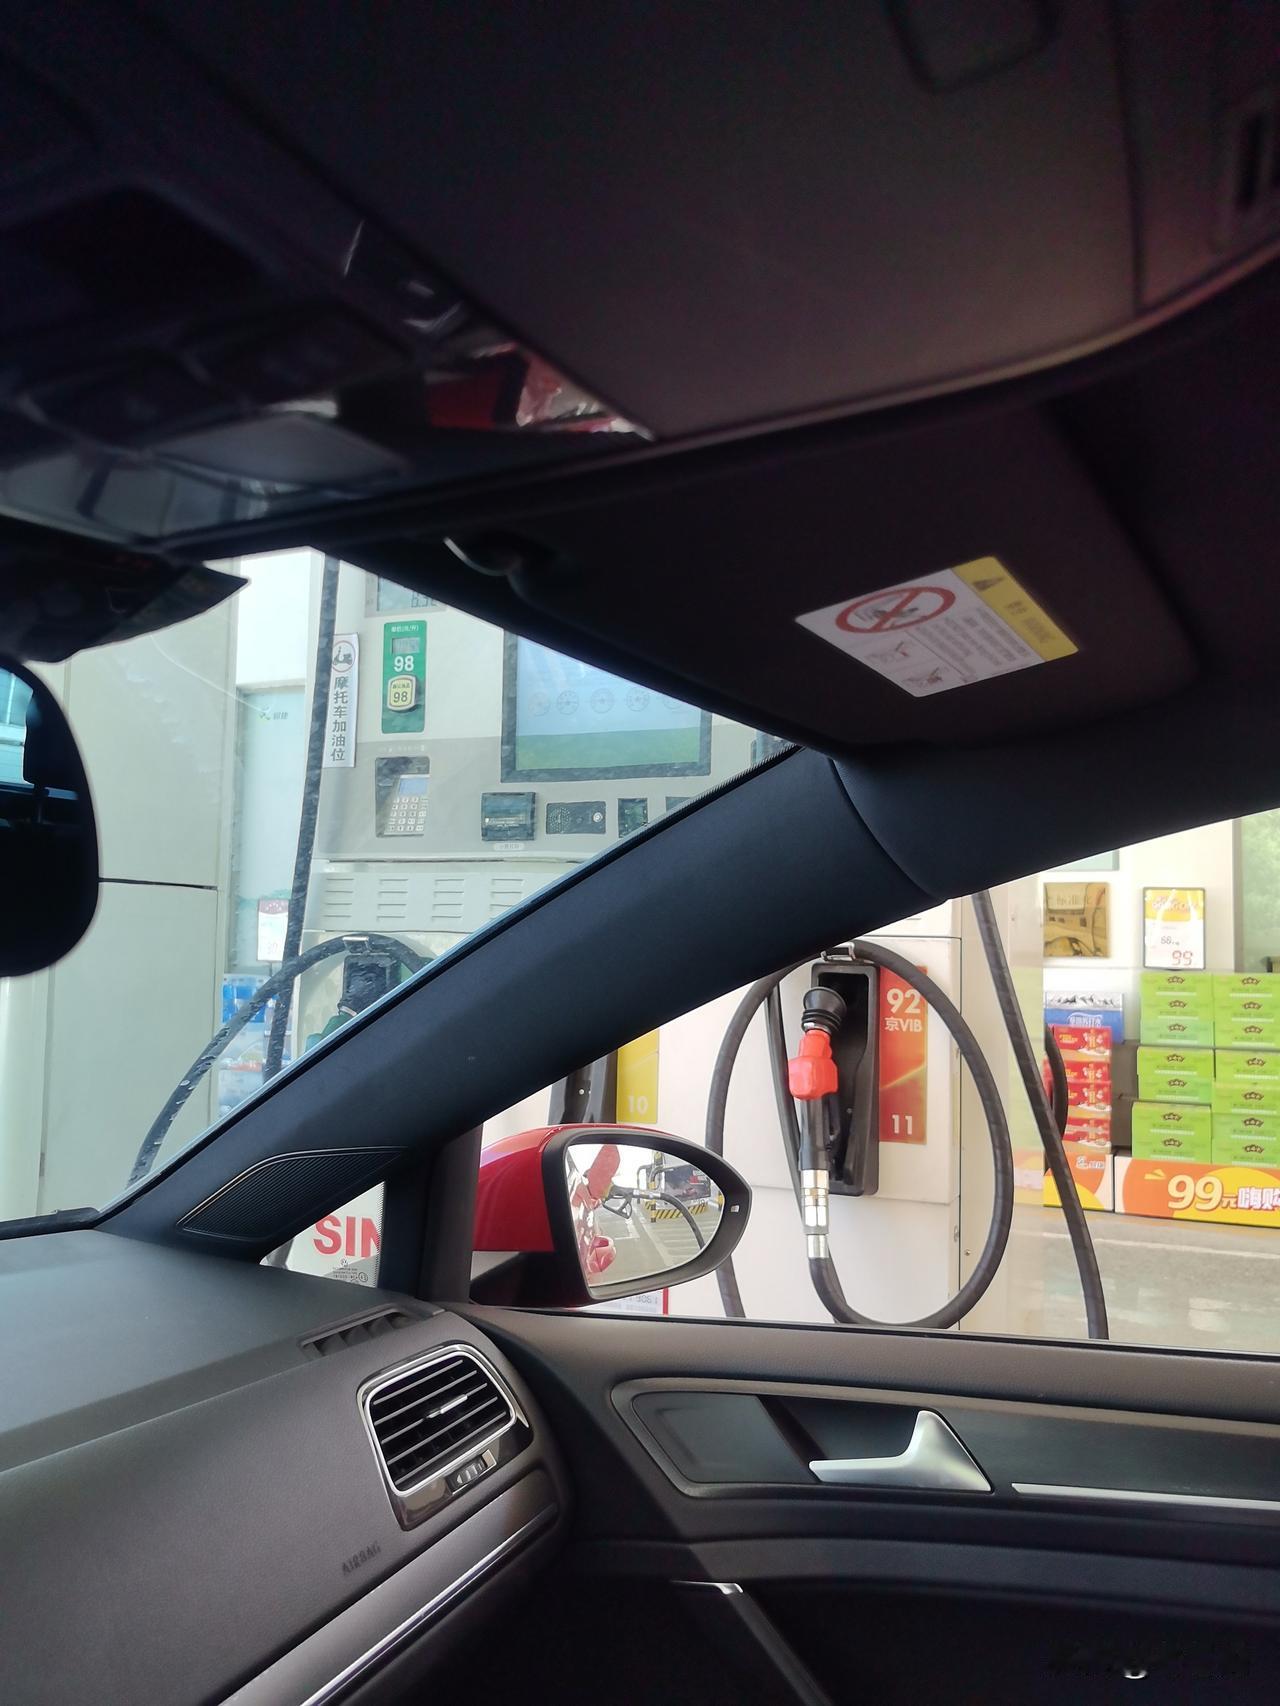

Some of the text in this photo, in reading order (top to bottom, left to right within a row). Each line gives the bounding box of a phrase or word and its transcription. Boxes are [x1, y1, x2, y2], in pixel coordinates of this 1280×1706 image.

[394, 655, 414, 672] 98
[393, 691, 408, 703] 98
[331, 676, 349, 761] 摩托车加油位
[886, 988, 921, 1014] 92
[628, 1095, 649, 1115] 10
[892, 1114, 913, 1135] 11
[342, 1540, 381, 1576] AIRBAG
